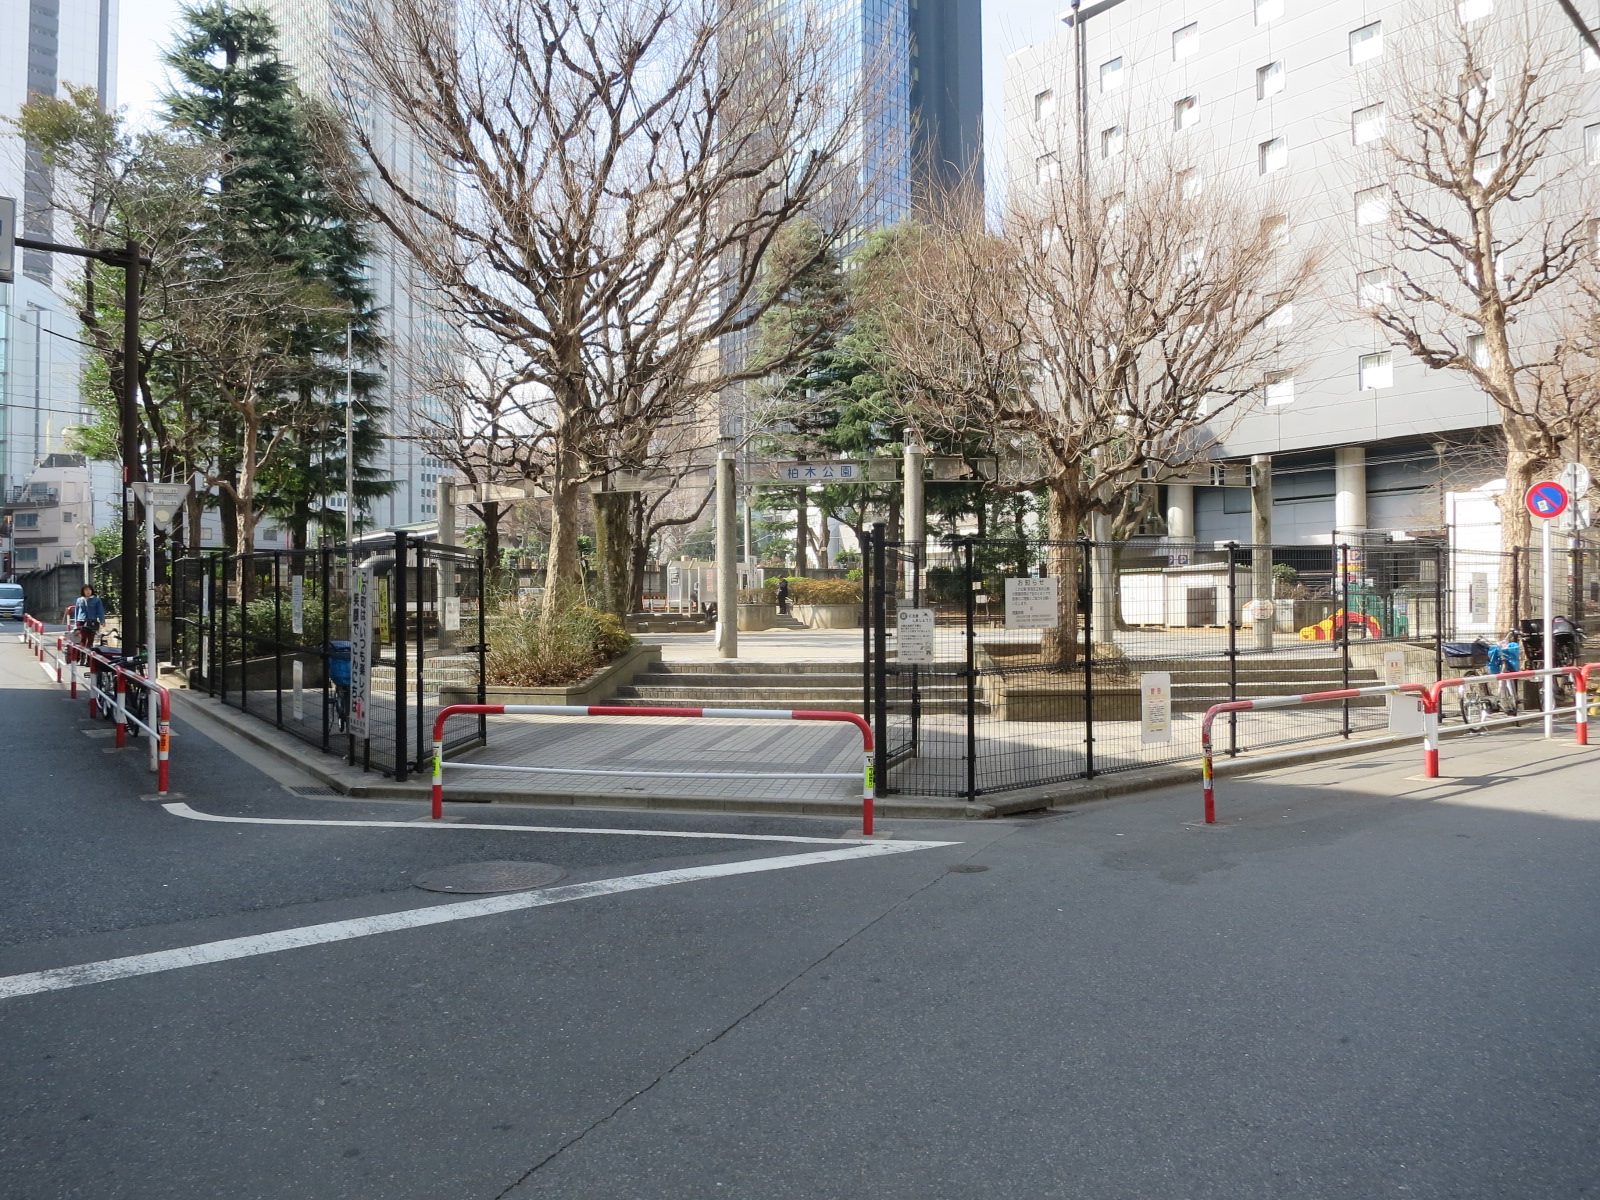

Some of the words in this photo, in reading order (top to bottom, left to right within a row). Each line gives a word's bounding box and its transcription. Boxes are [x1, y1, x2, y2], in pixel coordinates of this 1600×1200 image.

[787, 465, 852, 479] 柏木公園
[1017, 579, 1045, 587] お知らせ
[358, 572, 367, 702] この町は、いつも楽しく
[351, 641, 359, 713] こんにちは
